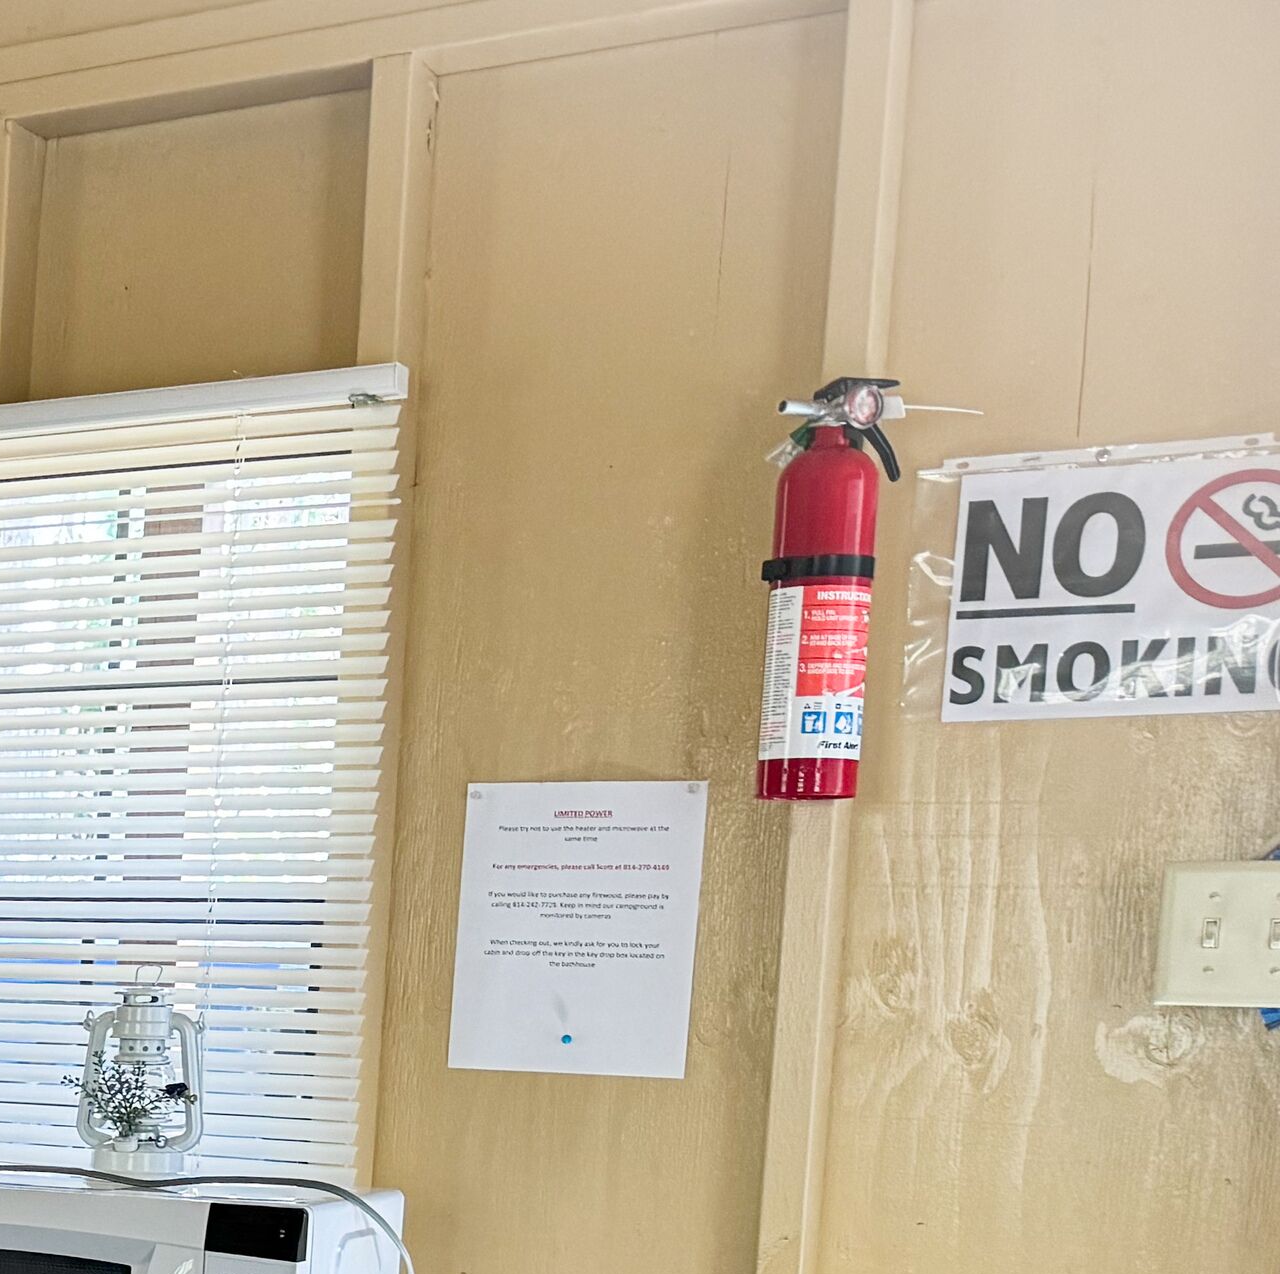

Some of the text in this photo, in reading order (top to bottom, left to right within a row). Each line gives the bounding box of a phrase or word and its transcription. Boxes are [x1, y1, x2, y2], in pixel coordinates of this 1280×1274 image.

[959, 491, 1147, 603] NO
[949, 634, 1280, 706] SMOKIN
[817, 740, 842, 749] First
[554, 810, 613, 818] LIMITED POWER
[491, 901, 511, 909] calling
